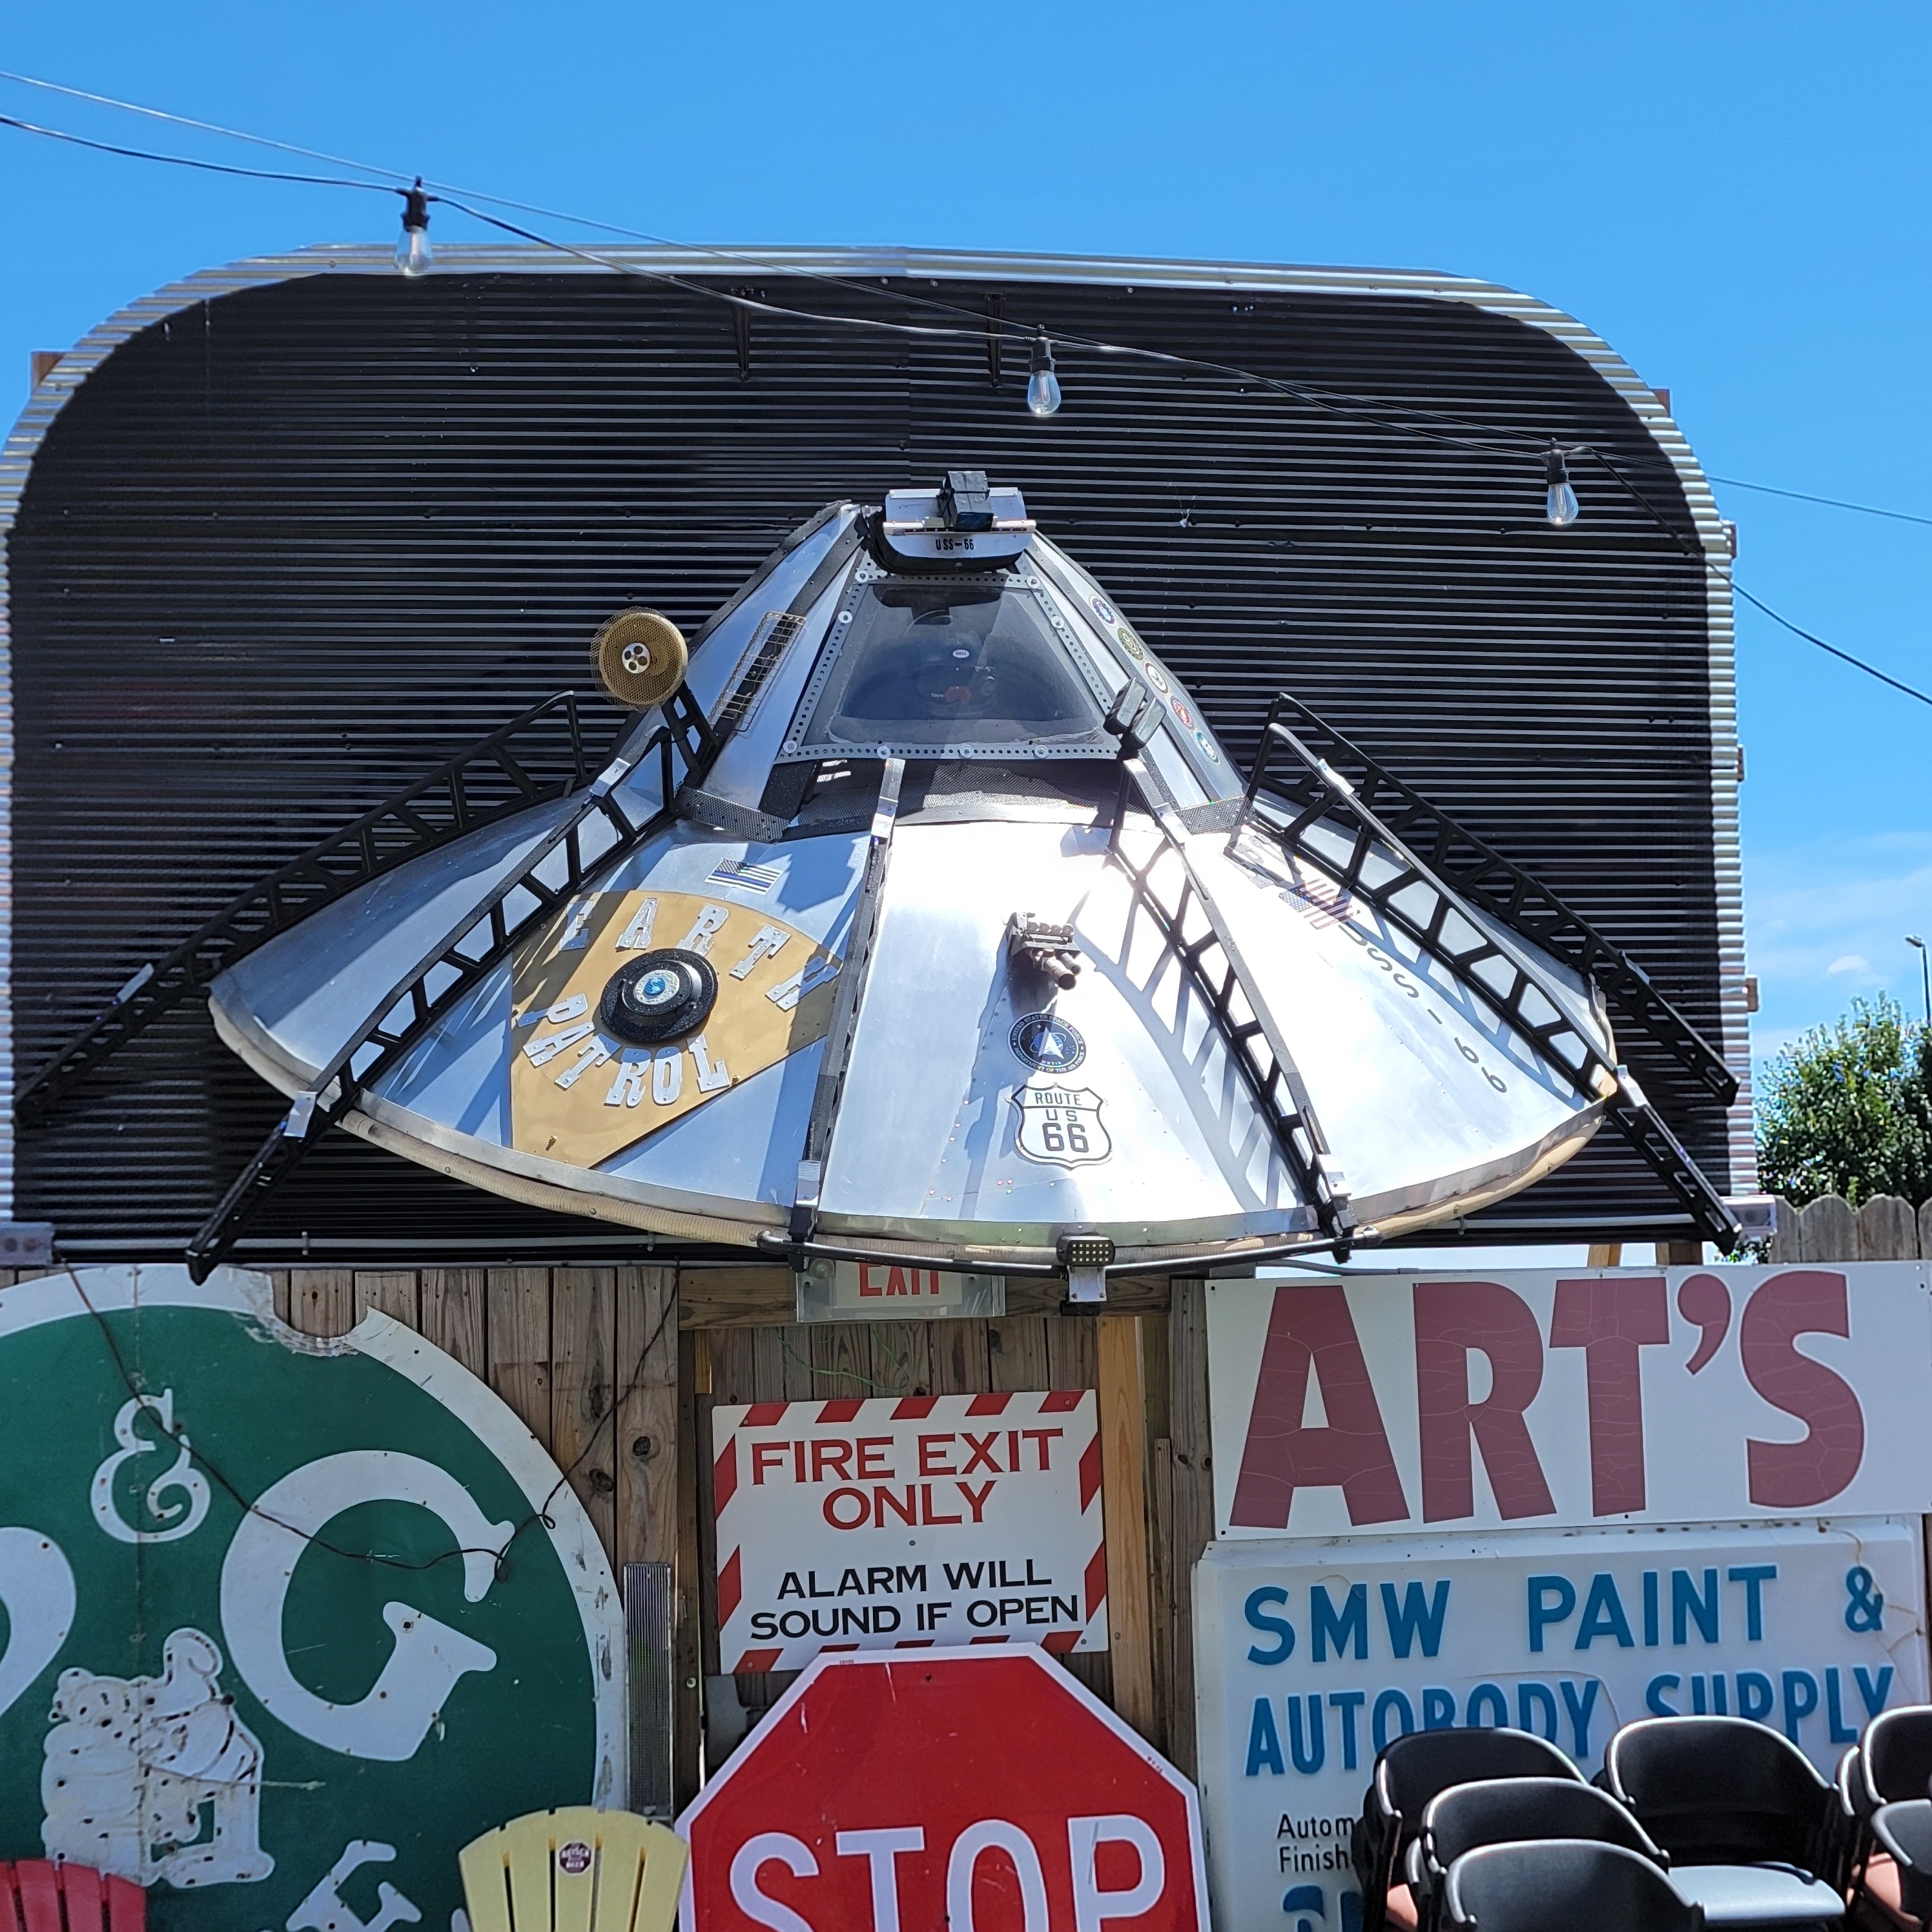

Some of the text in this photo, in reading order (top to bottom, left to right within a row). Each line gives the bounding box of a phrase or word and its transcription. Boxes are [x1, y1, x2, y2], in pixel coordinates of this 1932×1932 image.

[935, 538, 974, 551] USS-66
[559, 897, 839, 1012] EARTH
[517, 992, 731, 1107] PATROL
[1011, 1014, 1084, 1045] UNITED STATES SPACE FORCE
[1013, 1047, 1045, 1071] DEPARTMENT
[1068, 1063, 1077, 1071] AIR
[1075, 1051, 1085, 1067] FORCE
[1034, 1092, 1082, 1106] ROUTE
[1042, 1122, 1089, 1153] 66
[1228, 1269, 1865, 1529] ART'S
[751, 1427, 1064, 1485] FIRE EXIT
[822, 1479, 998, 1530] ONLY
[776, 1558, 1053, 1600] ALARM WILL
[750, 1594, 1079, 1641] SOUND IF OPEN
[1244, 1565, 1885, 1666] SMW PAINT &
[729, 1813, 1165, 1932] STOP
